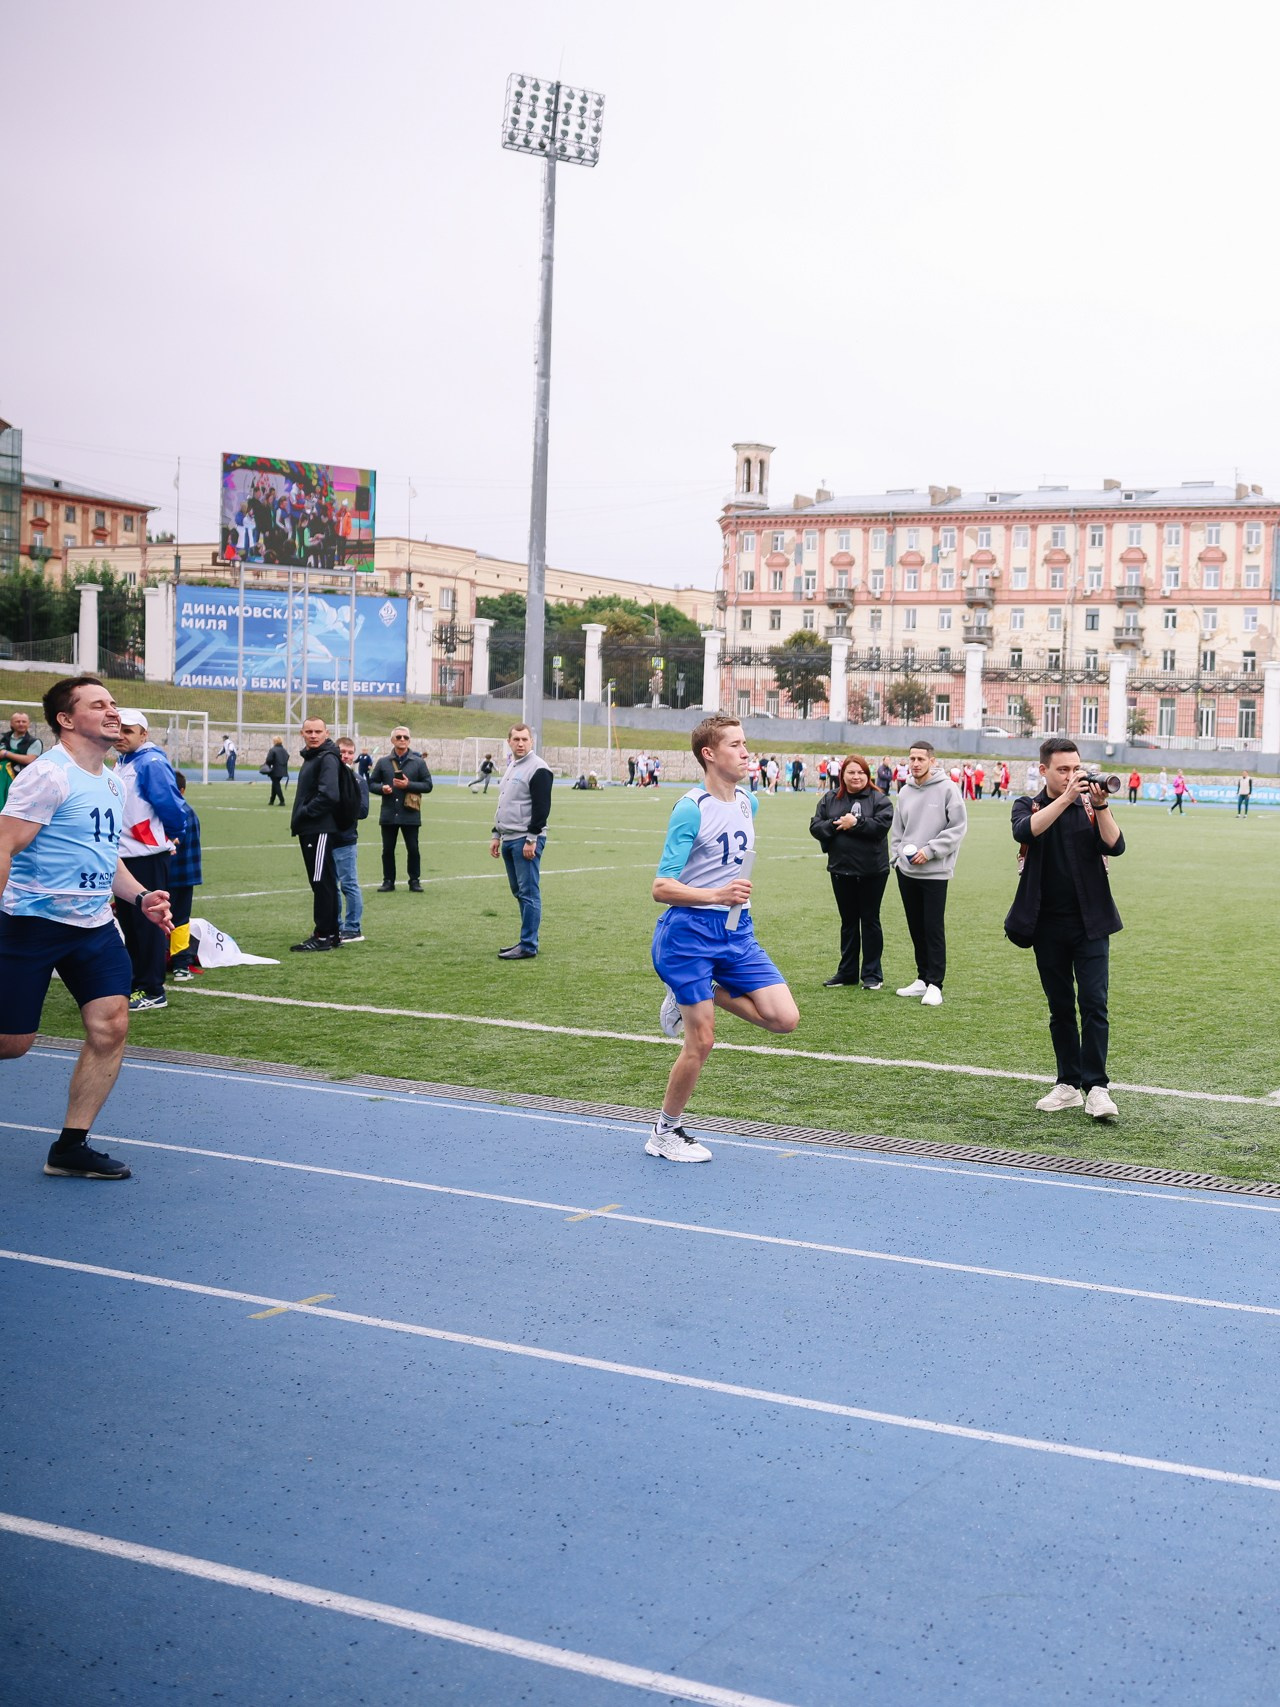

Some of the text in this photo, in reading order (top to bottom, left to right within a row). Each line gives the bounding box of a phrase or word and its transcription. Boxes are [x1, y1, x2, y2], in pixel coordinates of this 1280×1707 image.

[181, 616, 227, 631] МИЛЯ
[180, 673, 247, 688] ДИНАМО
[322, 680, 348, 692] ВСЕ
[353, 681, 400, 694] БЕГУТ!
[89, 807, 114, 842] 11
[716, 830, 749, 865] 13
